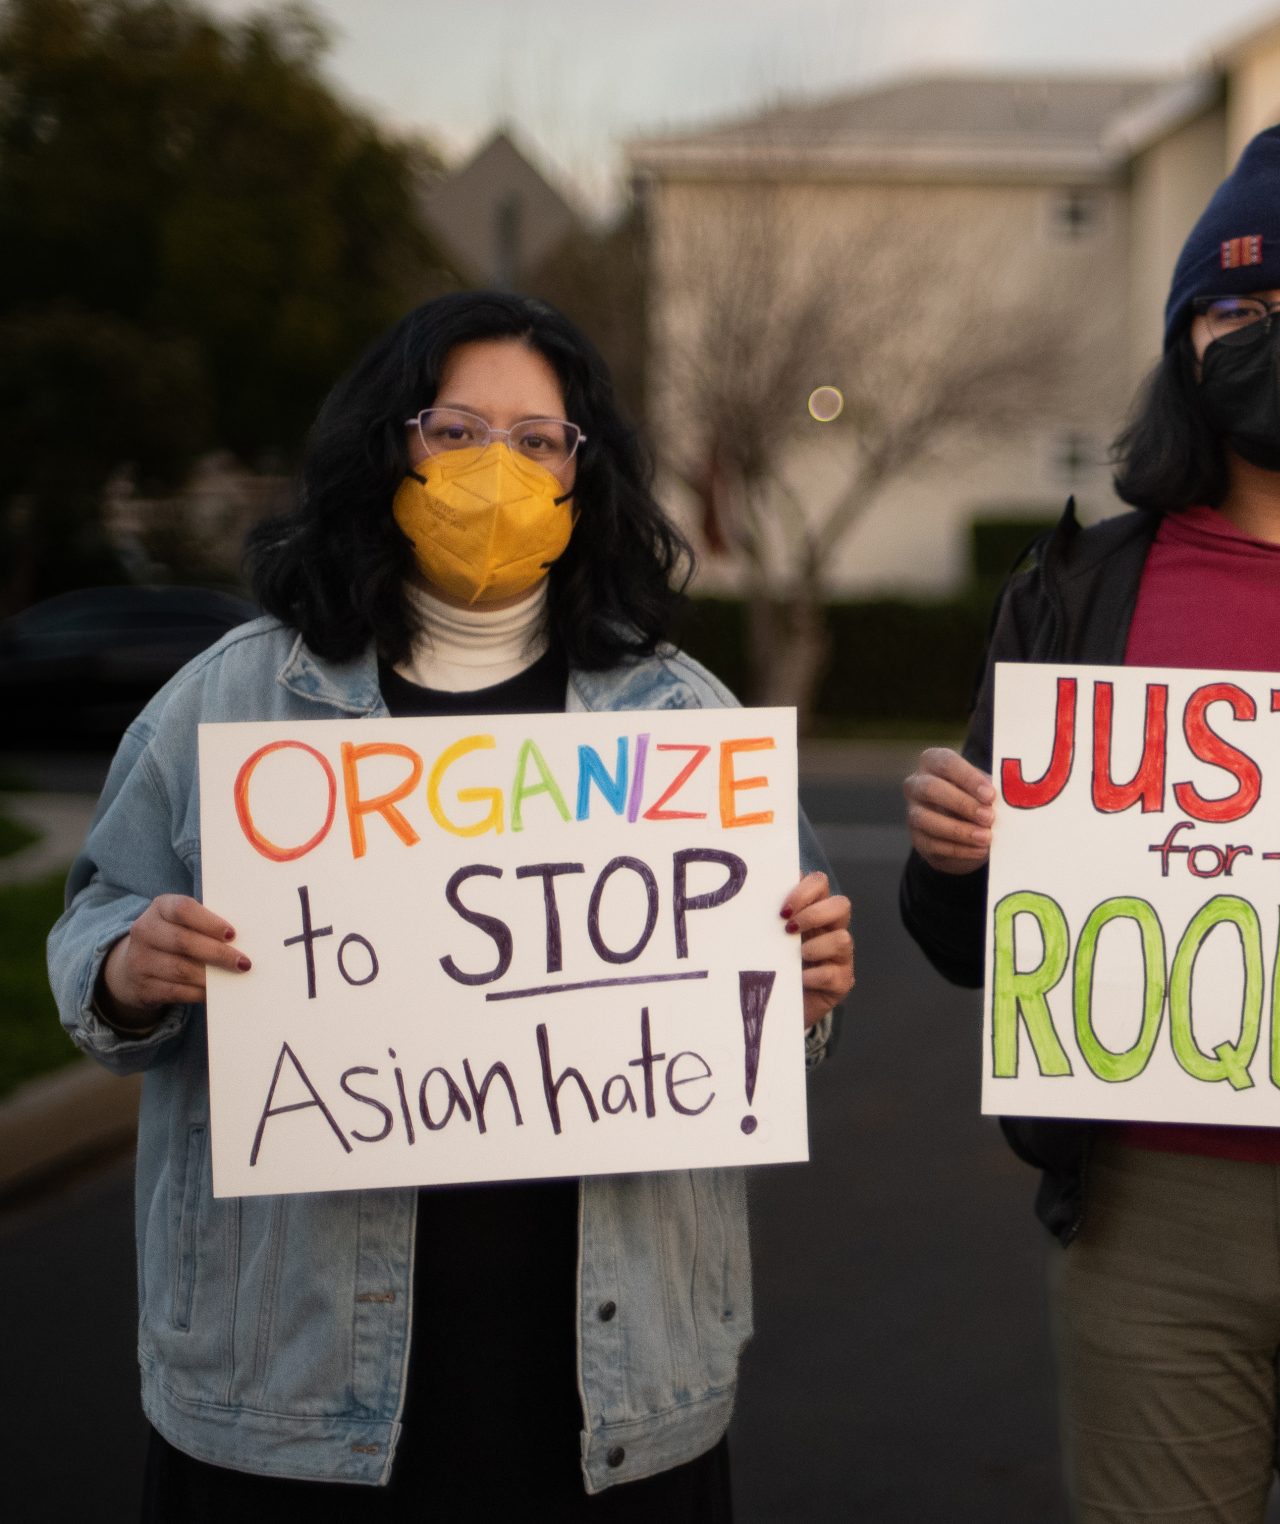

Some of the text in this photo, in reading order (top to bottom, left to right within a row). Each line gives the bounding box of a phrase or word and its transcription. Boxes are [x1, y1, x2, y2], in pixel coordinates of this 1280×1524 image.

[234, 733, 776, 863] ORGANIZE
[1148, 821, 1253, 878] for
[283, 848, 747, 999] to STOP
[249, 970, 776, 1167] Asian hate!
